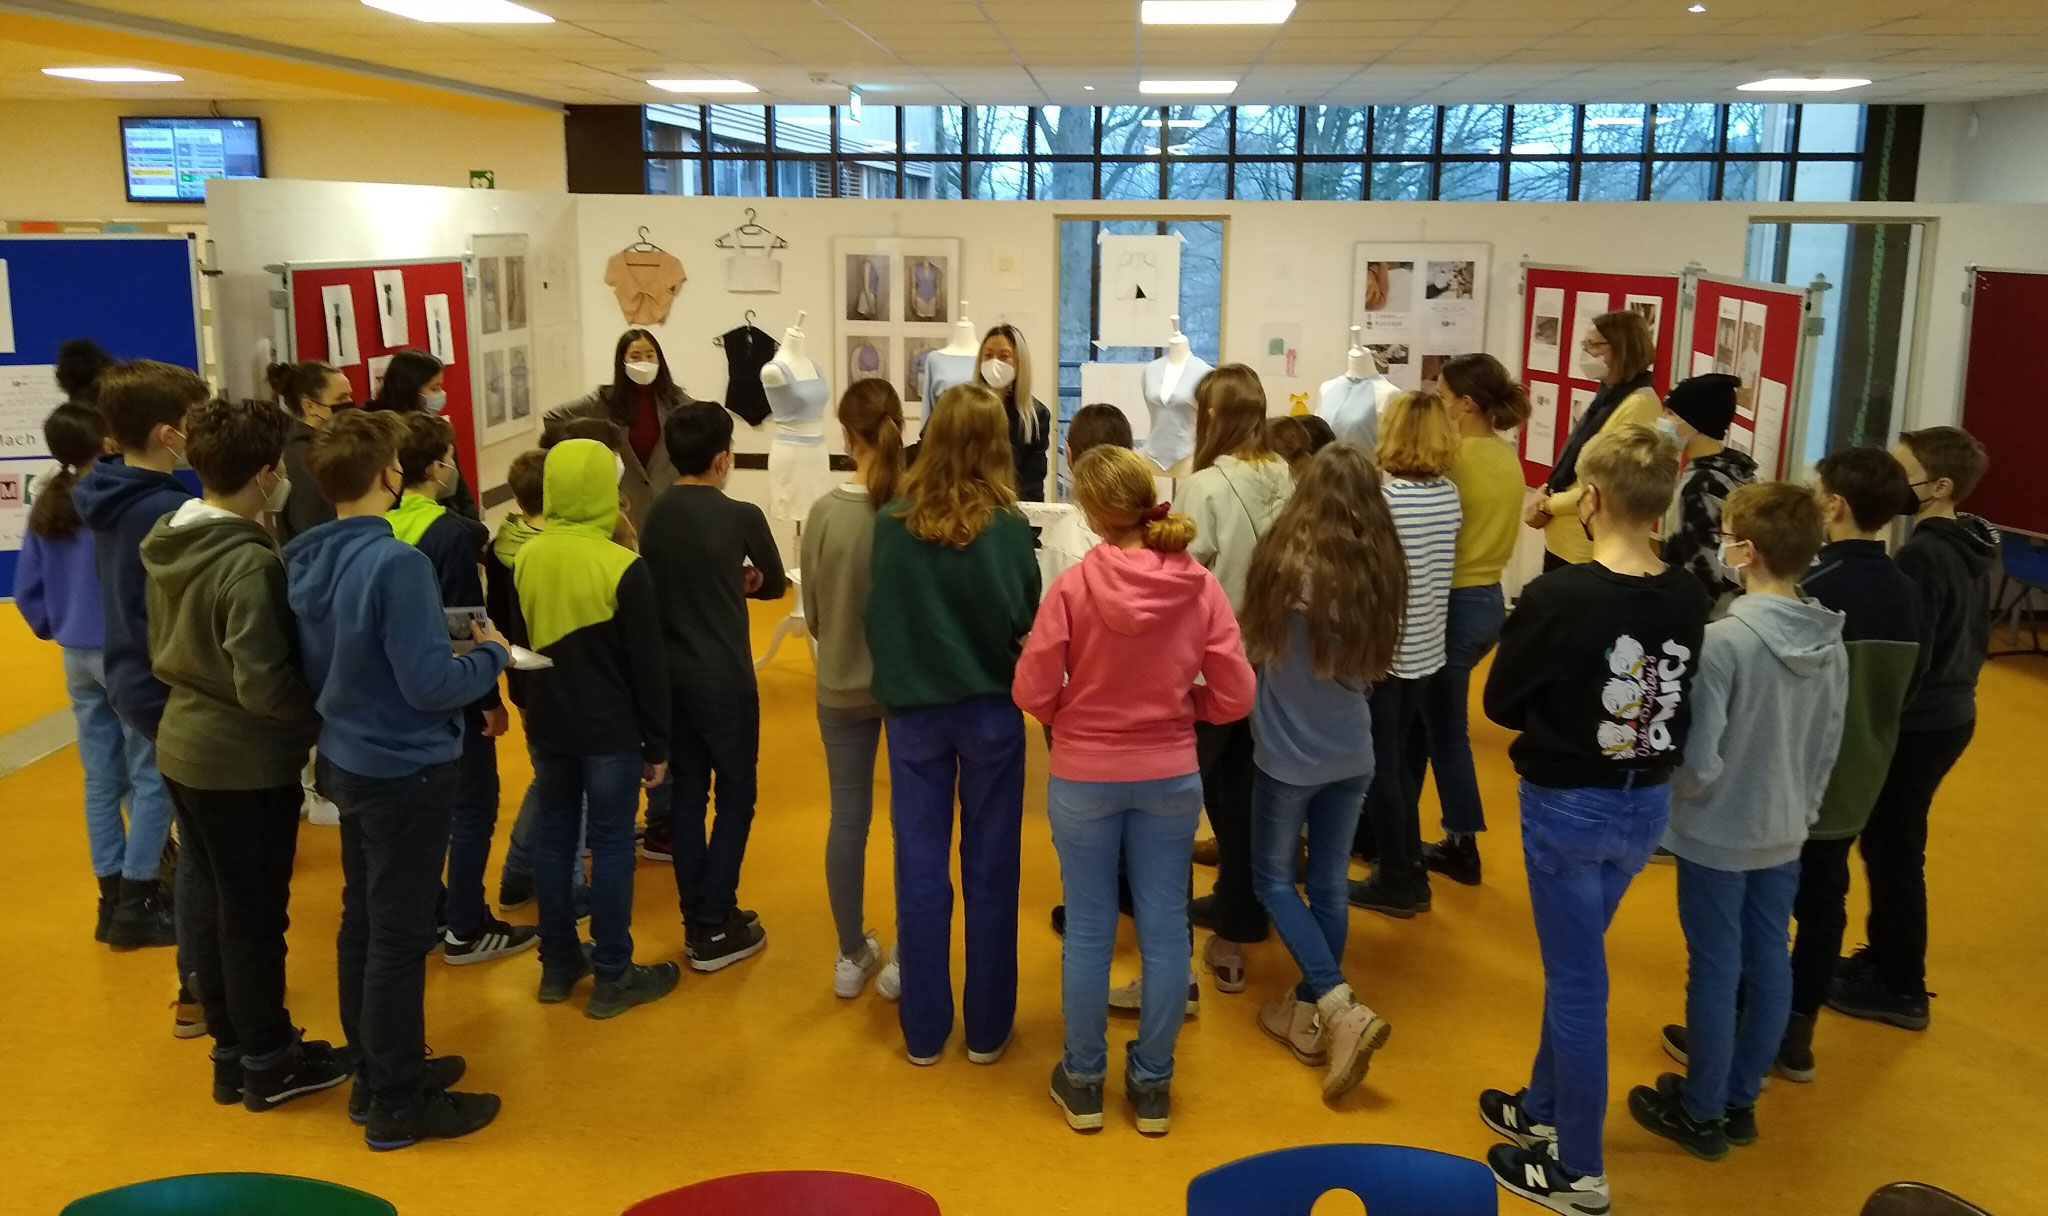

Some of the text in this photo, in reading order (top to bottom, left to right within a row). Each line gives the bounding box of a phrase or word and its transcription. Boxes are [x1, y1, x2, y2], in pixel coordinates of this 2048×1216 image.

[0, 432, 37, 447] ach
[1648, 638, 1692, 756] OMICS
[1502, 1103, 1519, 1130] N
[1524, 1163, 1549, 1189] N
